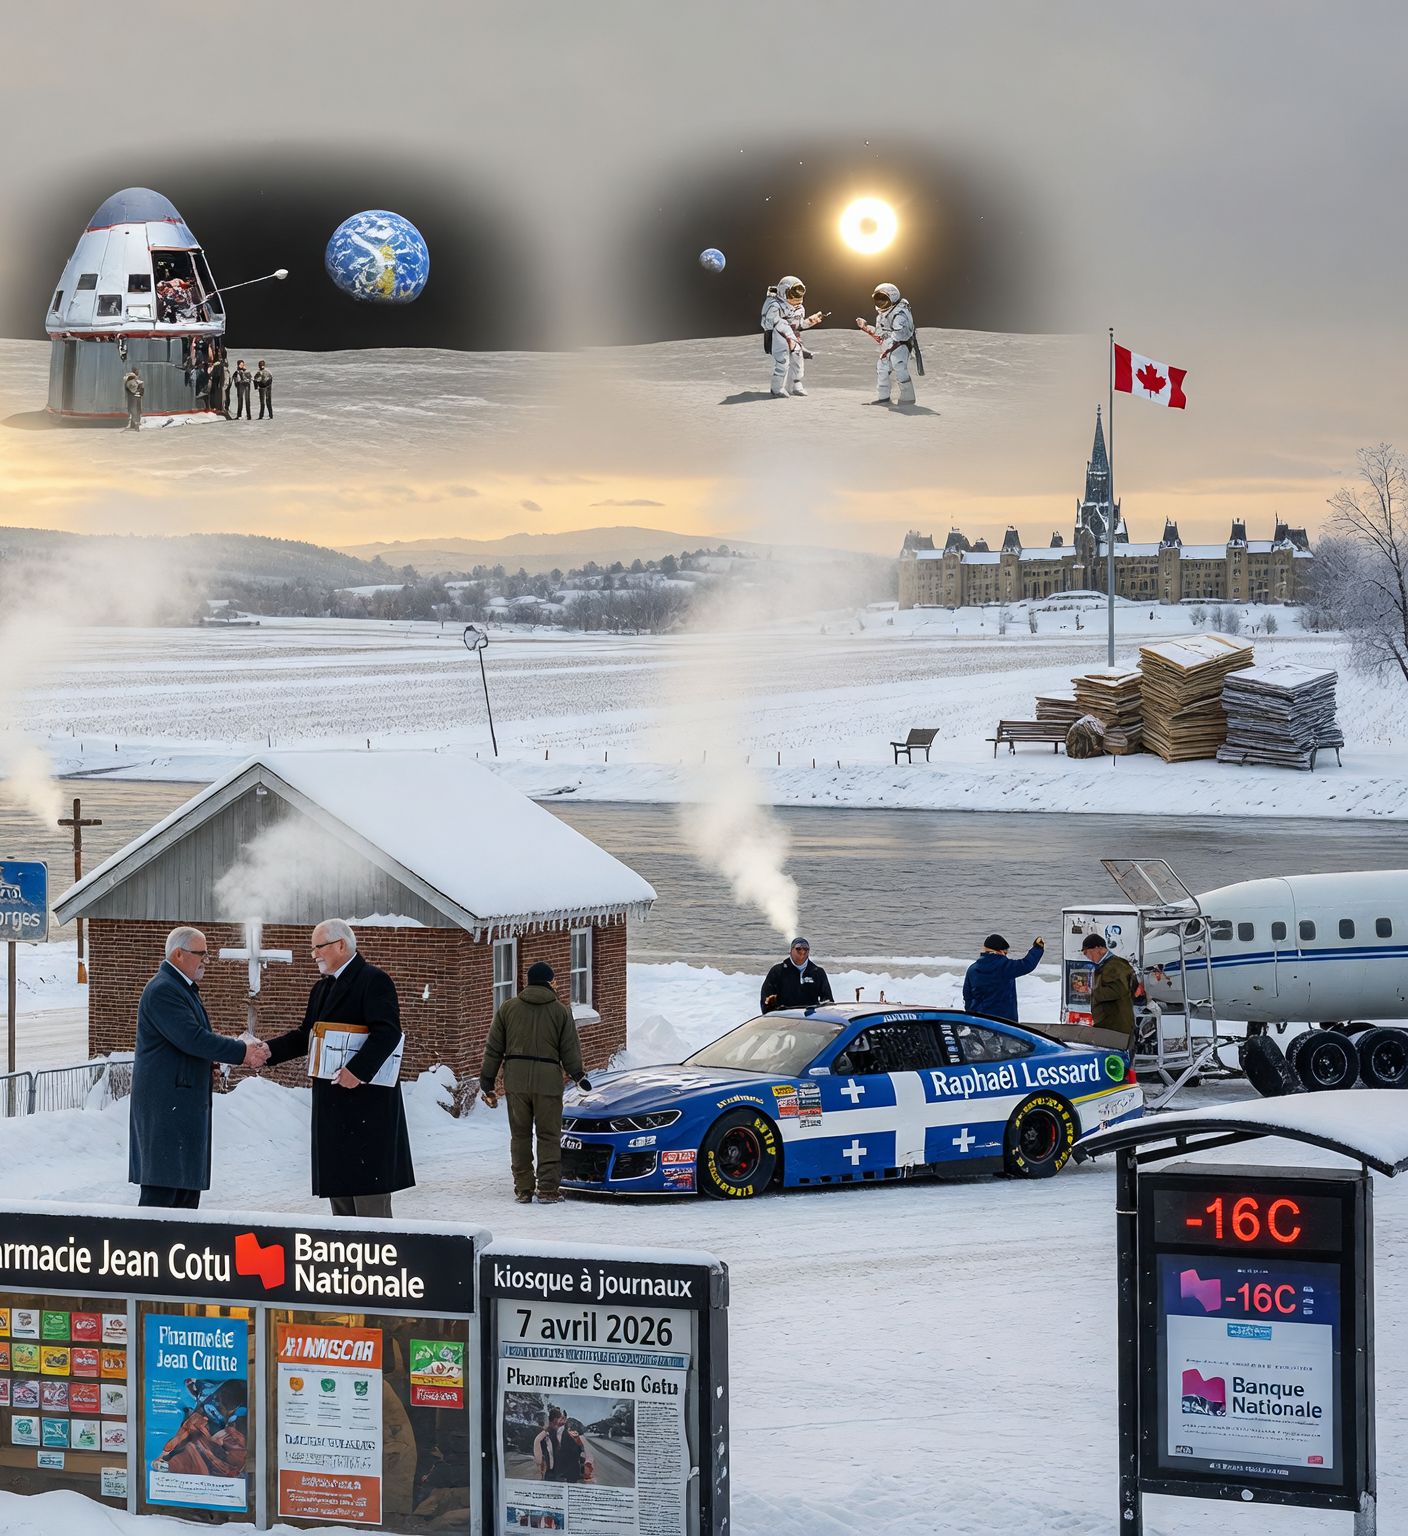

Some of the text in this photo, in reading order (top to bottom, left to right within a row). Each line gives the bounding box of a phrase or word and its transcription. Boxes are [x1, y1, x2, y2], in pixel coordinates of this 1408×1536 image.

[1021, 1058, 1101, 1087] Lessard
[1186, 1197, 1301, 1242] -16C
[98, 1239, 159, 1278] Jean
[168, 1243, 230, 1281] Cotu
[295, 1233, 398, 1271] Banque
[295, 1264, 424, 1298] Nationale
[494, 1263, 692, 1299] kiosque à journaux
[1225, 1282, 1297, 1314] -16C
[516, 1309, 673, 1347] 7 avril 2026
[156, 1349, 188, 1369] Jean
[1232, 1376, 1304, 1400] Banque
[1232, 1396, 1323, 1418] Nationale
